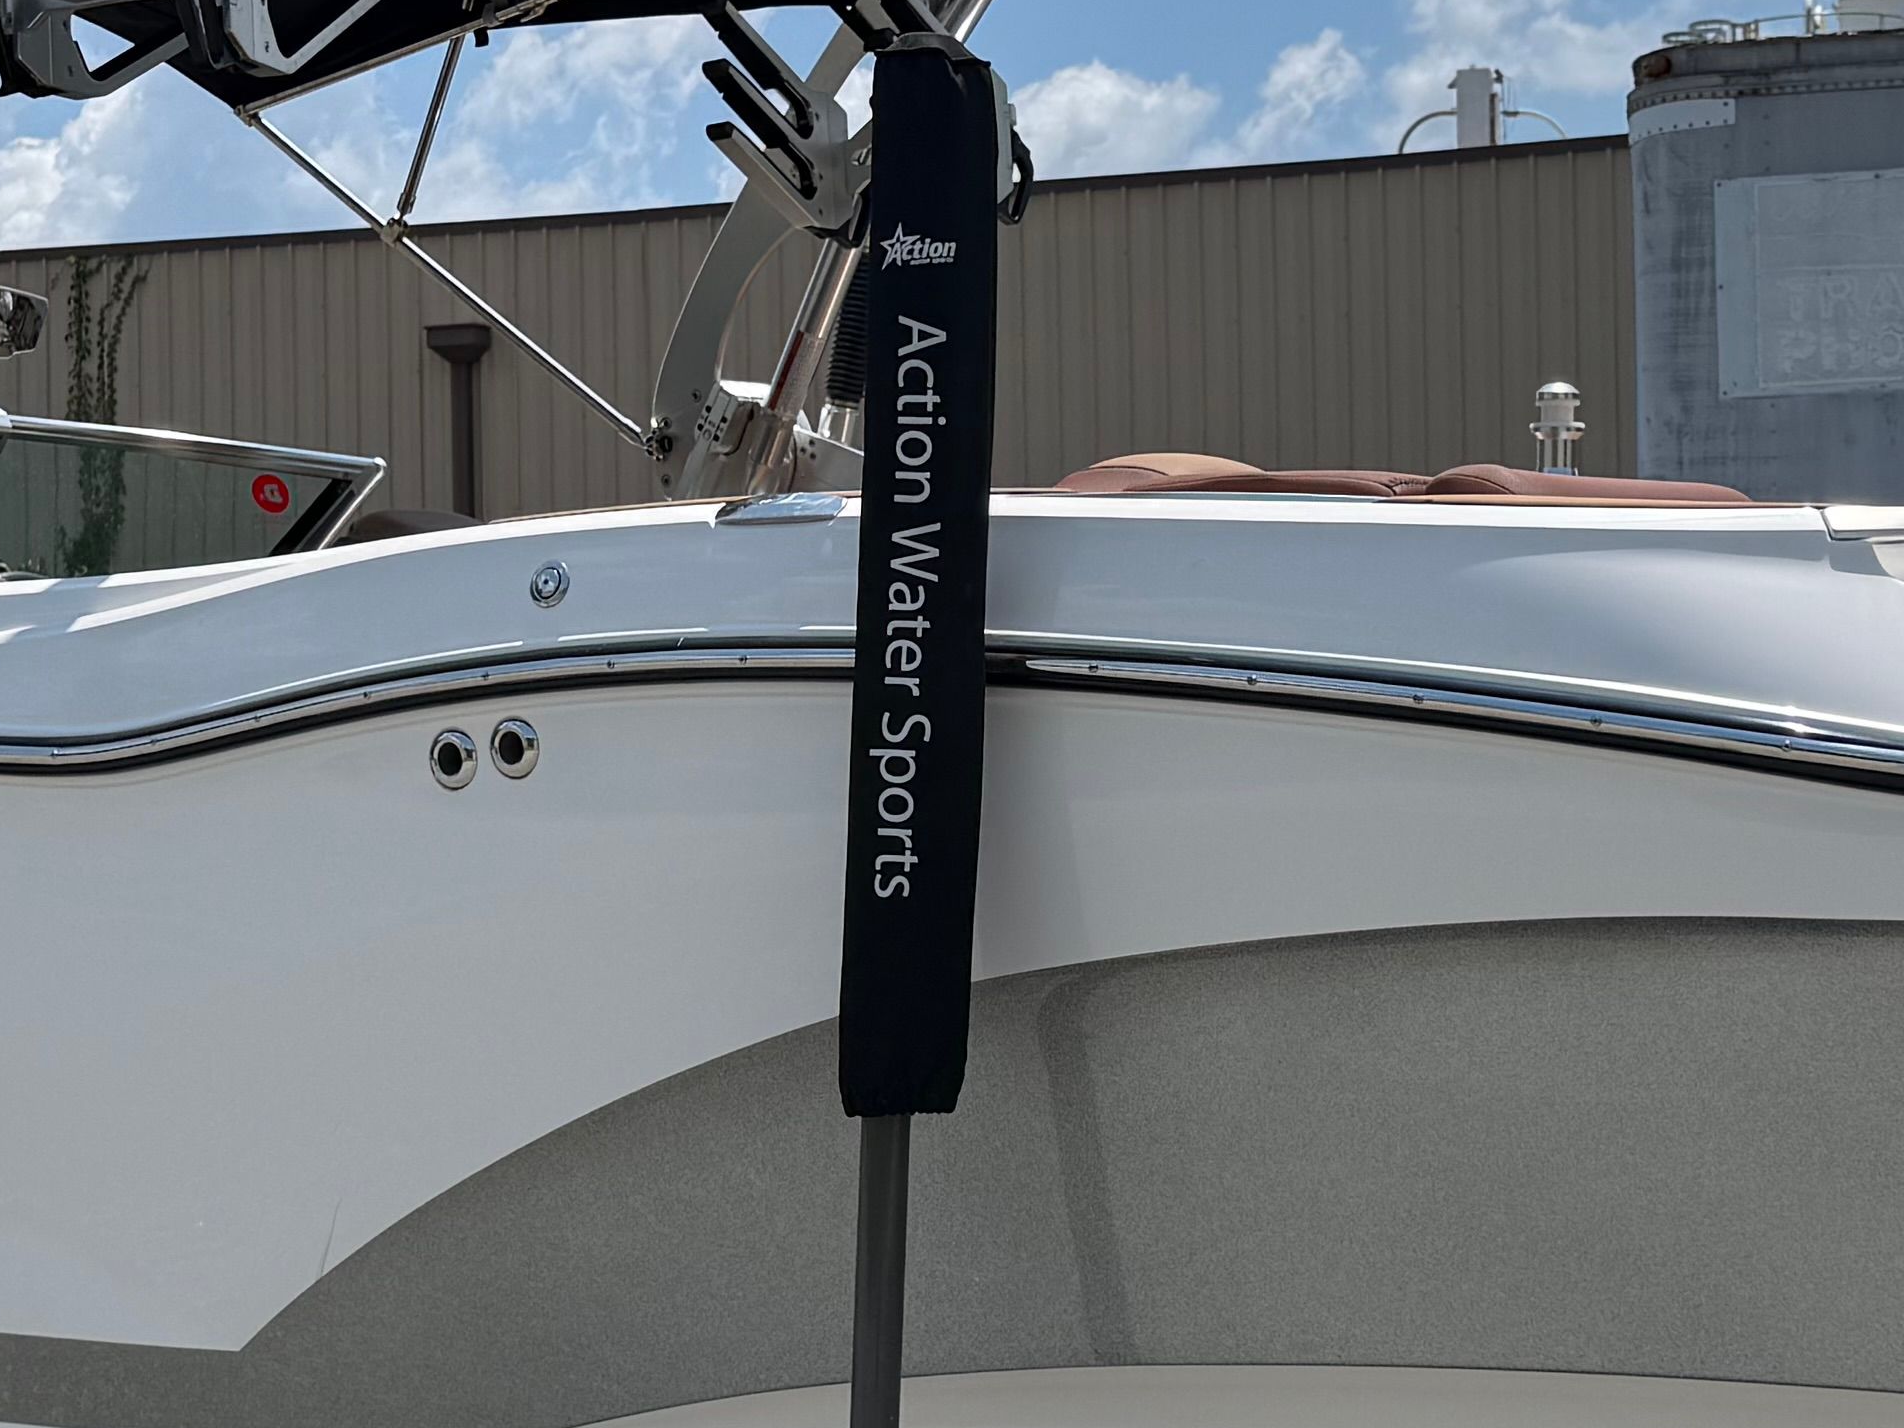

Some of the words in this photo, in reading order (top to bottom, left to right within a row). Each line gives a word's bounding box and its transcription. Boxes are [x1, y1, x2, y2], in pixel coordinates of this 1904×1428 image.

[888, 237, 957, 267] Action
[893, 314, 947, 504] Action
[883, 521, 942, 697] Water
[869, 711, 932, 899] Sports
